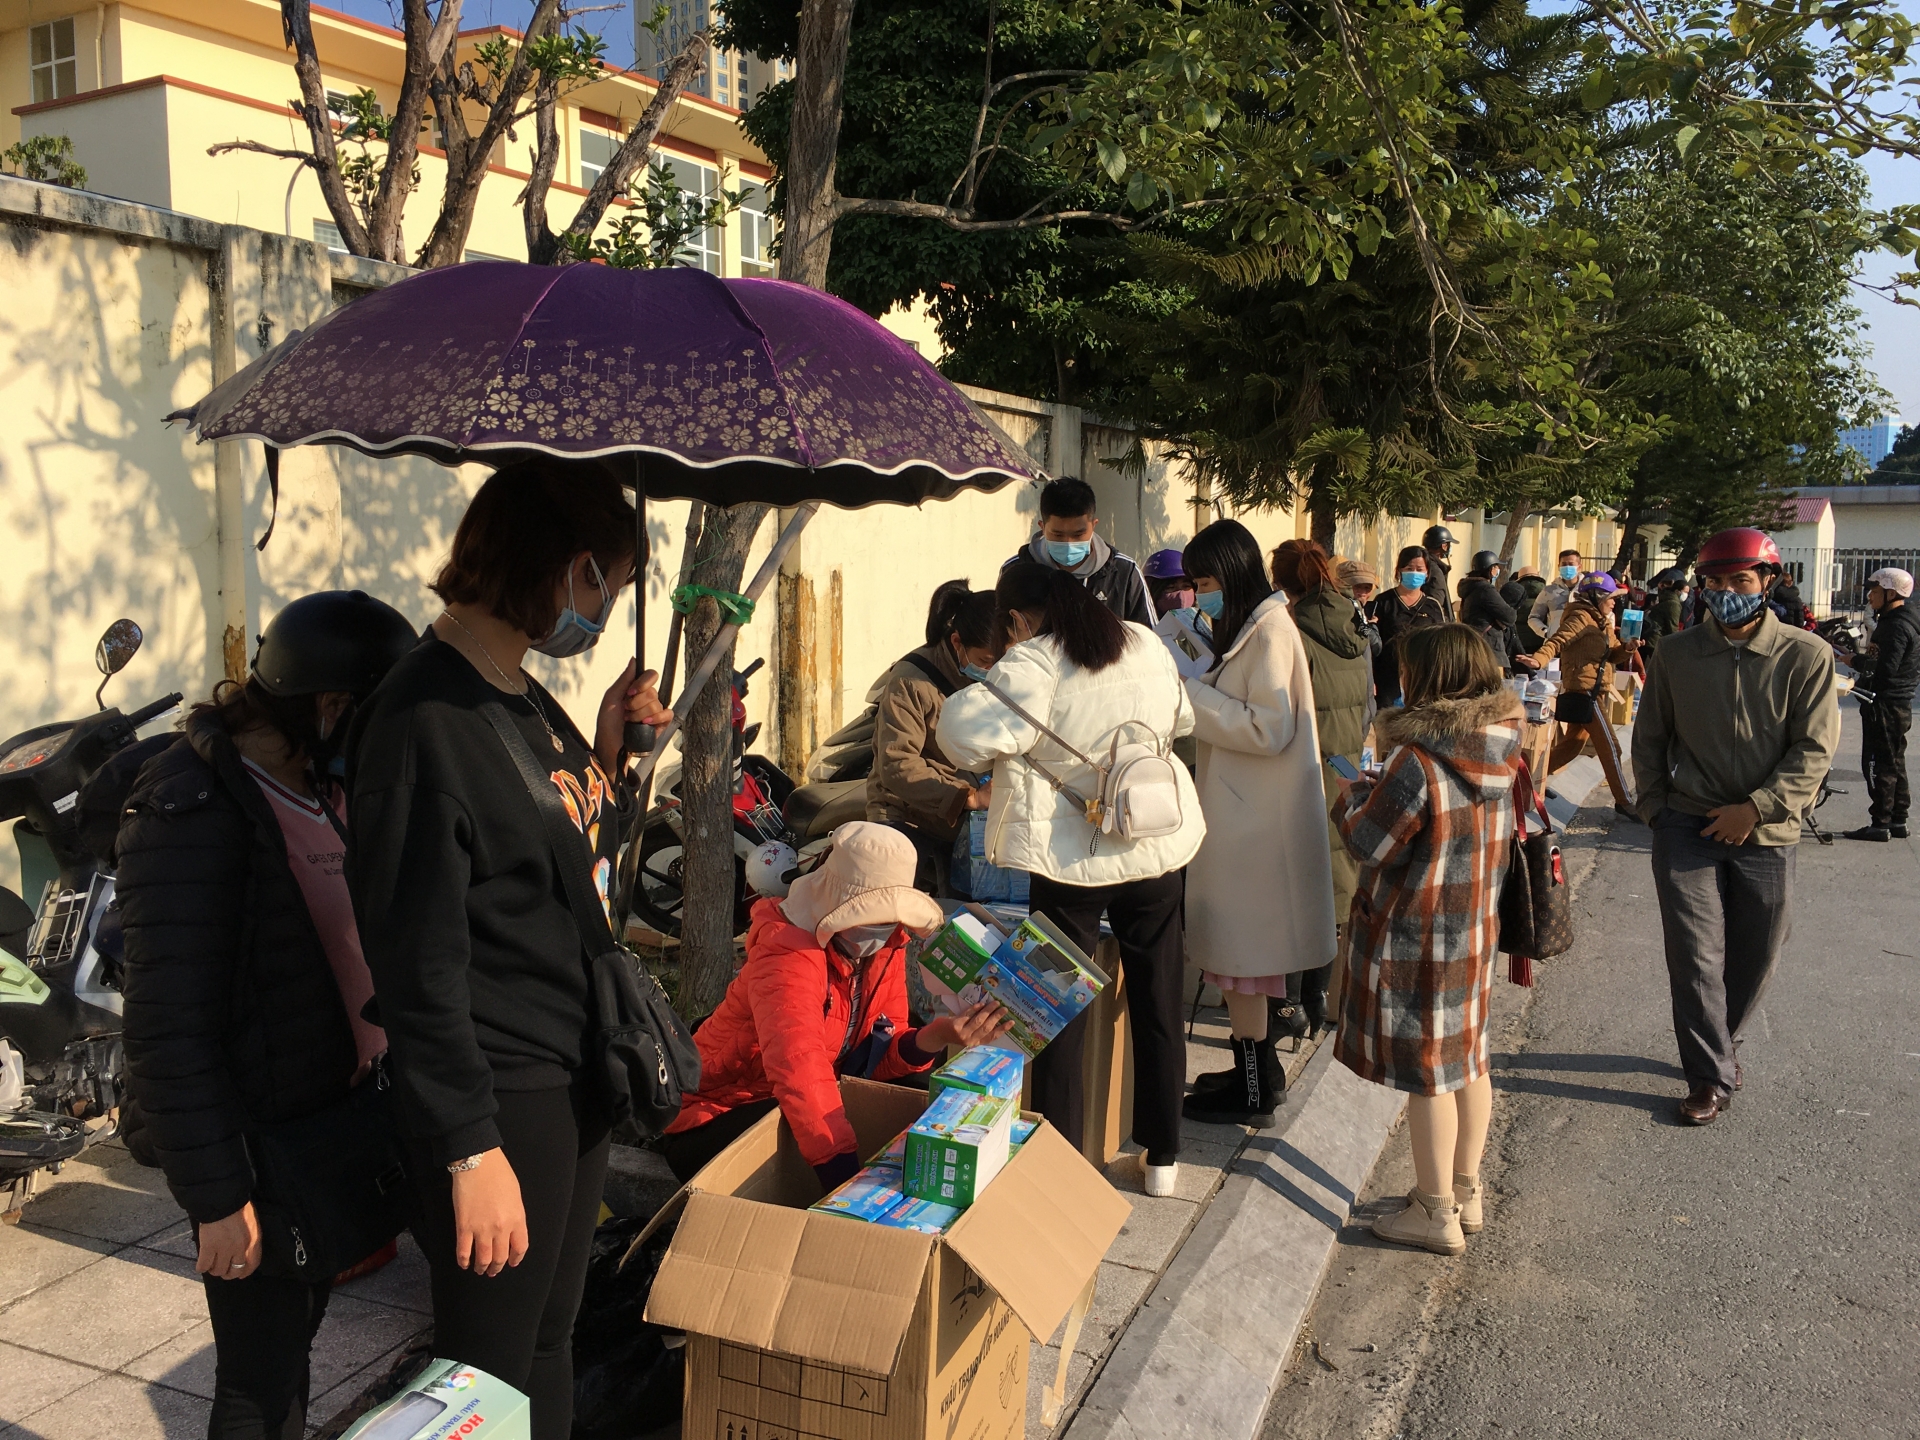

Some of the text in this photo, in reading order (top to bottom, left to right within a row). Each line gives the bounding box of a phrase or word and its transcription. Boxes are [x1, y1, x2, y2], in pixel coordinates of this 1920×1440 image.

[1034, 1009, 1054, 1027] HEALTH
[958, 1354, 980, 1394] TRANG
[438, 1414, 463, 1433] TRANG
